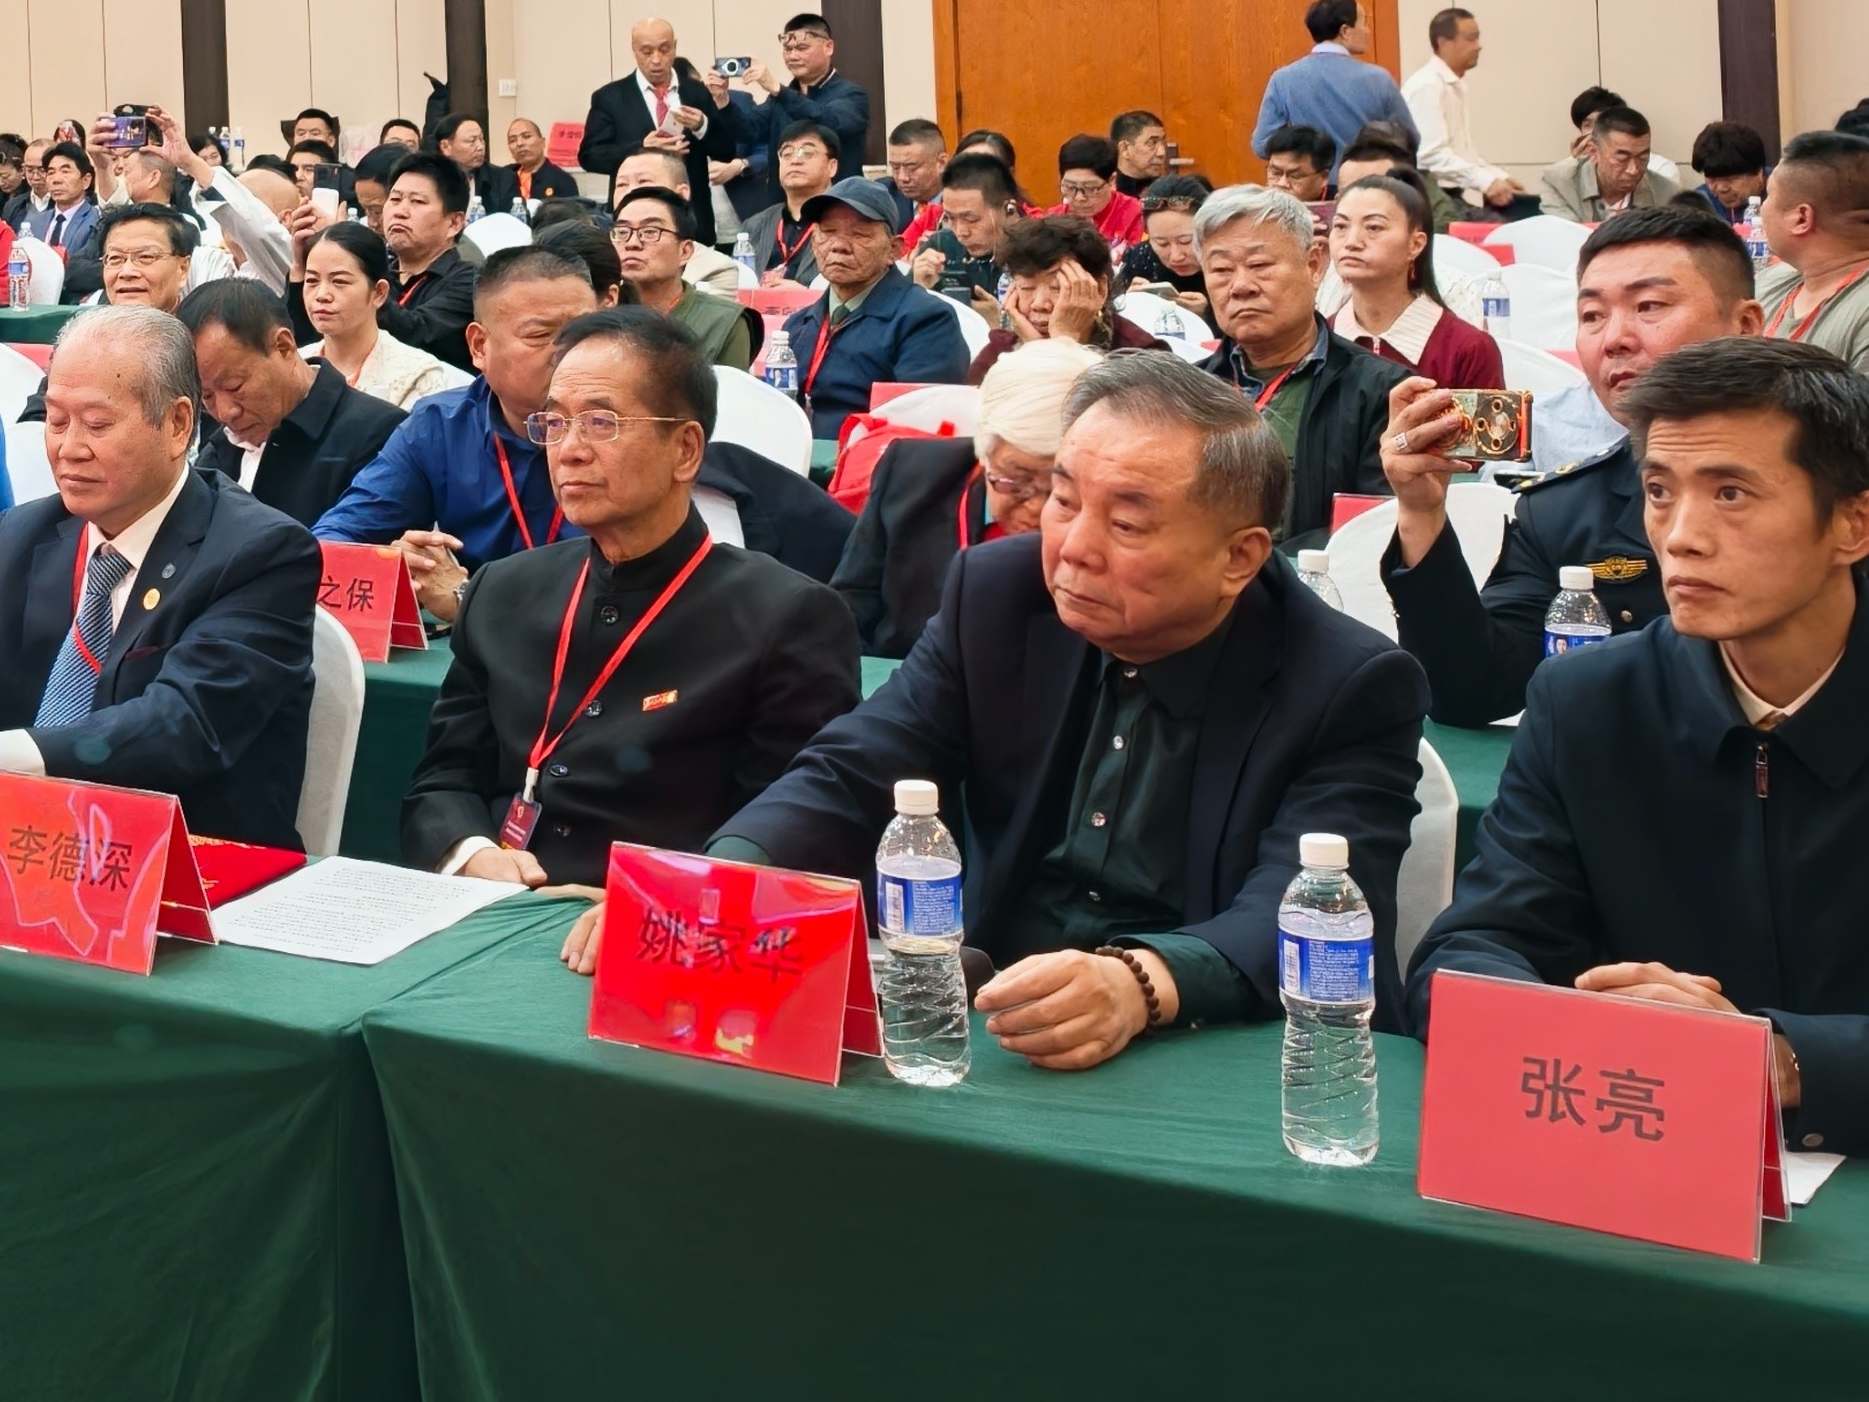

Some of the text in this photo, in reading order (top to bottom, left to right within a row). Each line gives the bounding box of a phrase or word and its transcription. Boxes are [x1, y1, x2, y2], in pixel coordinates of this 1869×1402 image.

[6, 823, 134, 892] 李德深
[636, 905, 804, 985] 姚家华
[1519, 1053, 1668, 1143] 张亮
